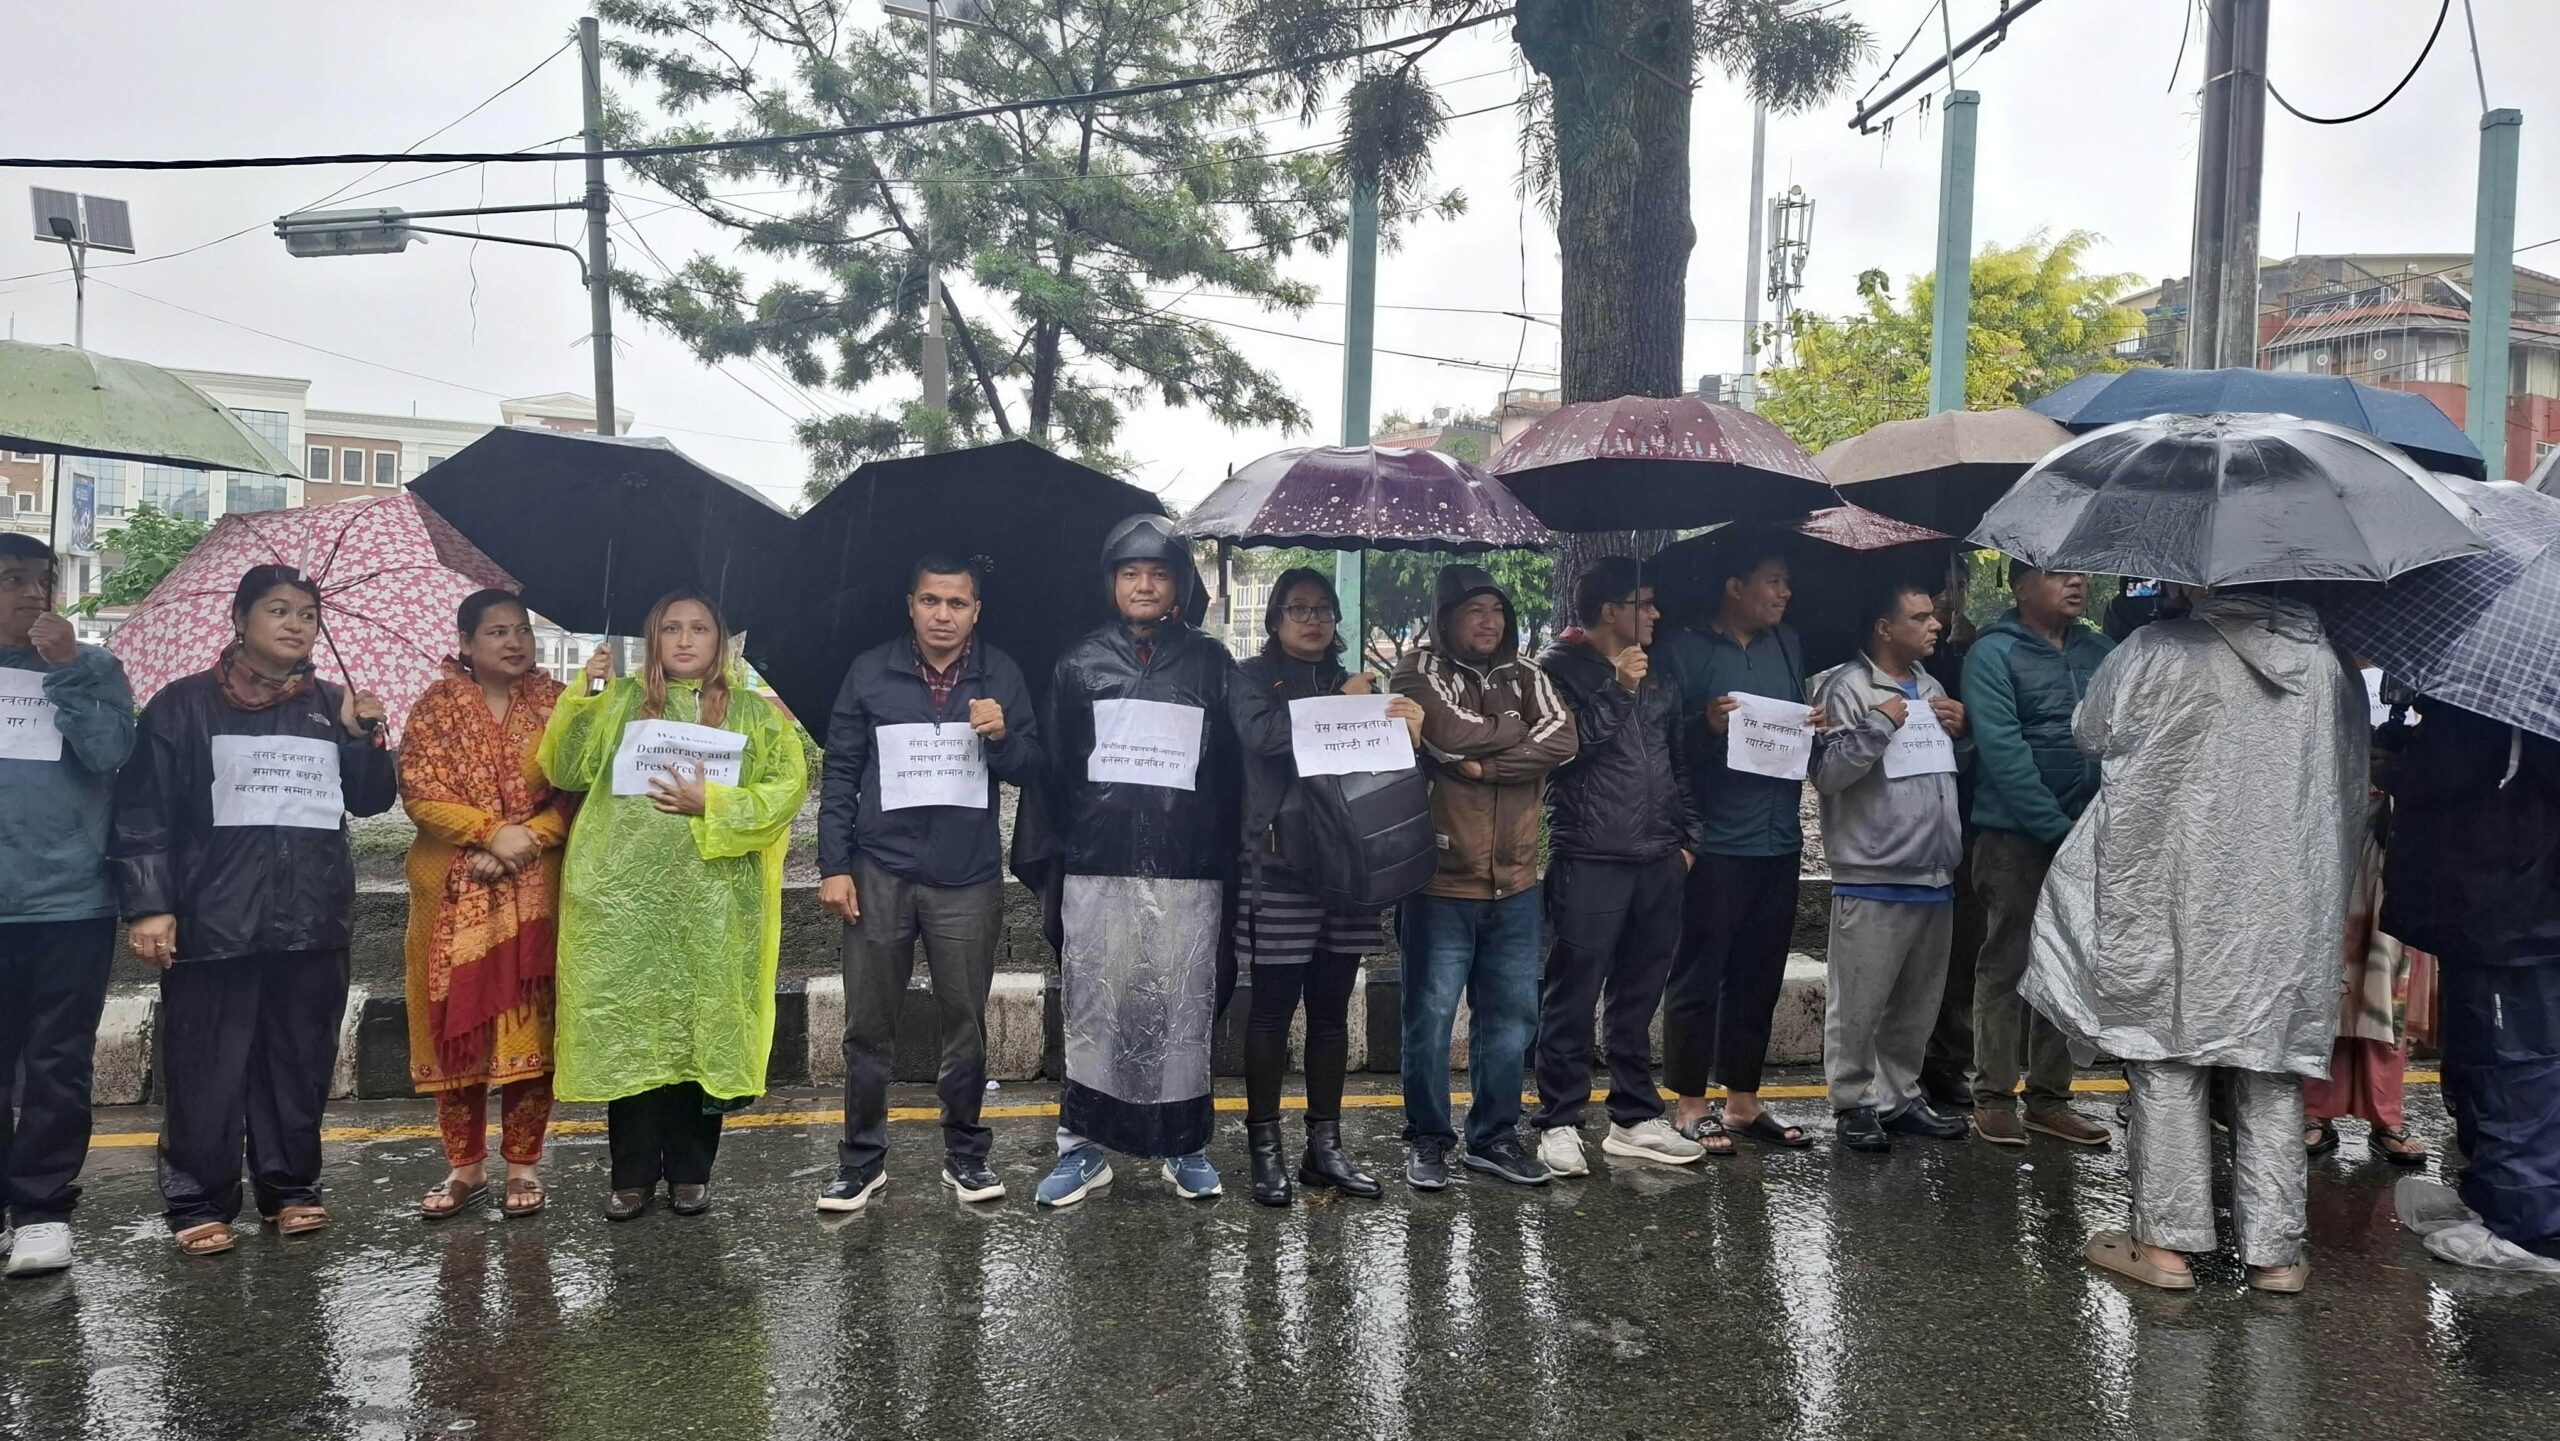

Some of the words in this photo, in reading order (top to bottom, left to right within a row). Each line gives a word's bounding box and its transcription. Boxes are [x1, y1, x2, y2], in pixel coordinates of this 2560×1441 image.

[1315, 721, 1330, 733] प्रेस
[1336, 719, 1393, 732] स्वतन्त्रताको
[1743, 715, 1757, 728] प्रेस
[1762, 722, 1803, 738] स्वतन्त्रताको
[637, 743, 704, 760] Democracy
[708, 752, 731, 760] and
[1324, 738, 1361, 751] ग्यारेन्टी
[1367, 738, 1380, 748] गर
[1745, 737, 1776, 752] ग्यारेन्टी
[1779, 744, 1789, 752] गर
[319, 757, 325, 765] र
[909, 754, 942, 762] समाचार
[636, 761, 667, 771] Press
[672, 761, 719, 777] freeom
[897, 769, 932, 778] स्वतन्त्रता
[937, 768, 963, 777] सम्मान
[1169, 762, 1180, 771] गर
[252, 767, 291, 777] समाचार
[296, 769, 322, 781] कक्षको
[234, 784, 279, 794] स्वतन्त्रता
[284, 785, 312, 797] सम्मान
[316, 790, 328, 799] गर
